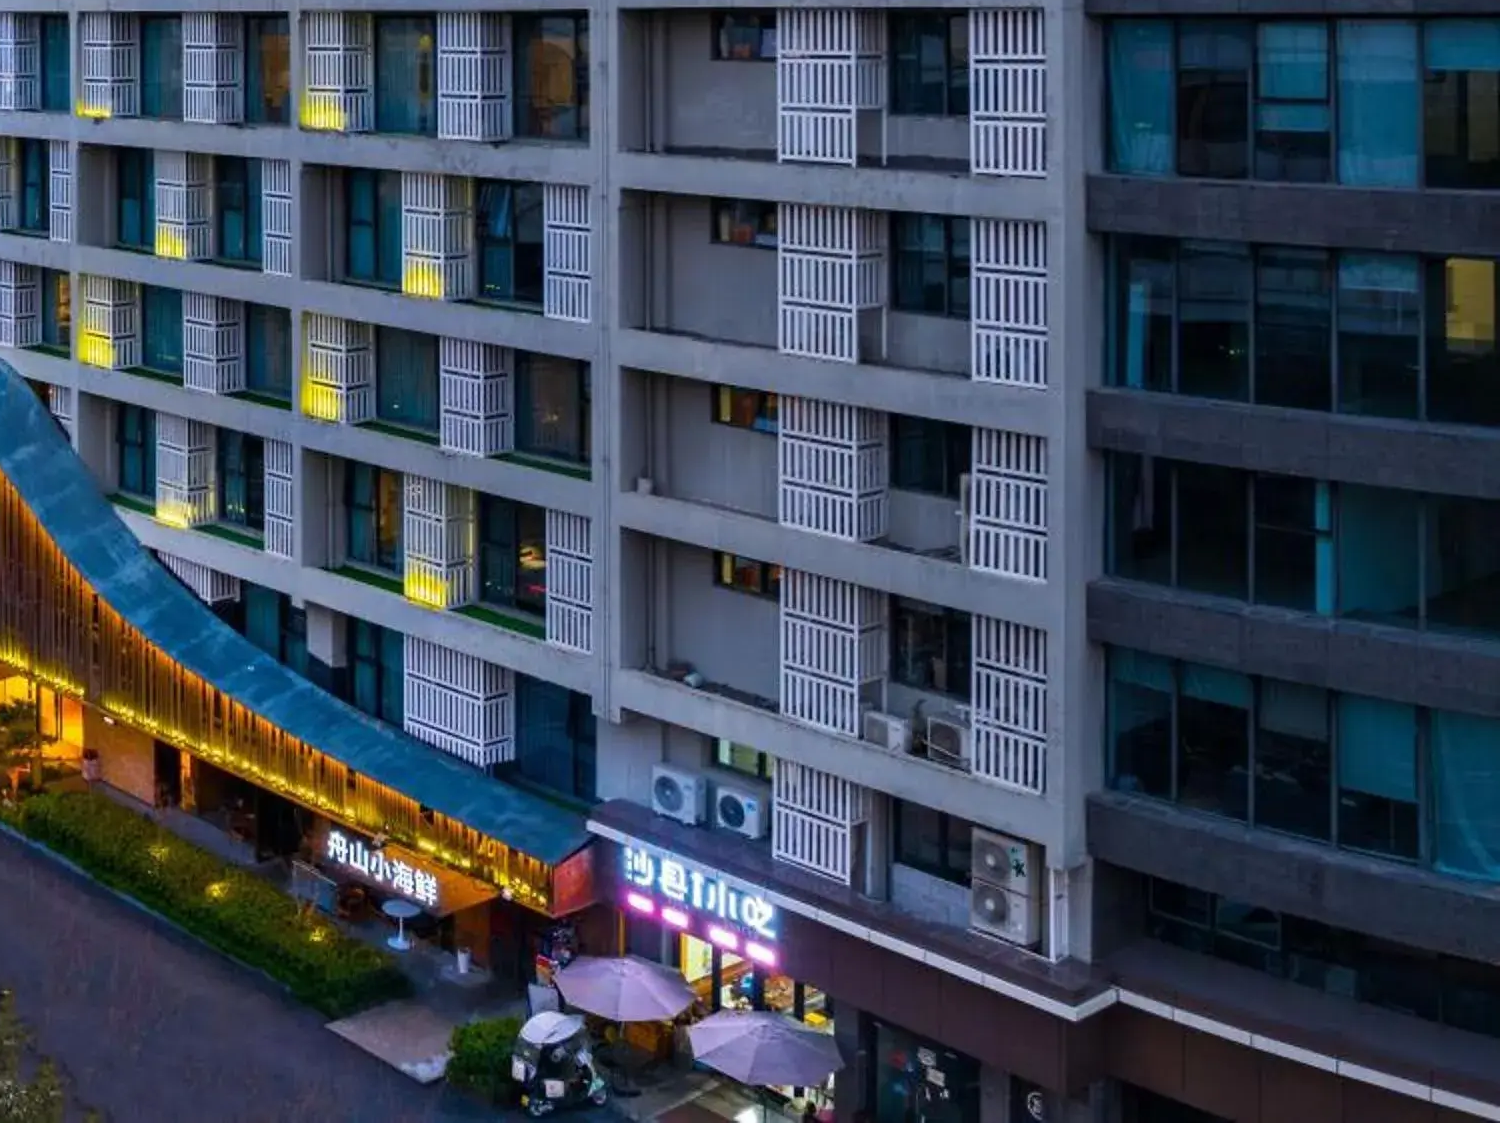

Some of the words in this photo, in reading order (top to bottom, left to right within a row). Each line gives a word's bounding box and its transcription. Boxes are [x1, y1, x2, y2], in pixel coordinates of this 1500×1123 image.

[327, 830, 438, 907] 舟山小海鲜
